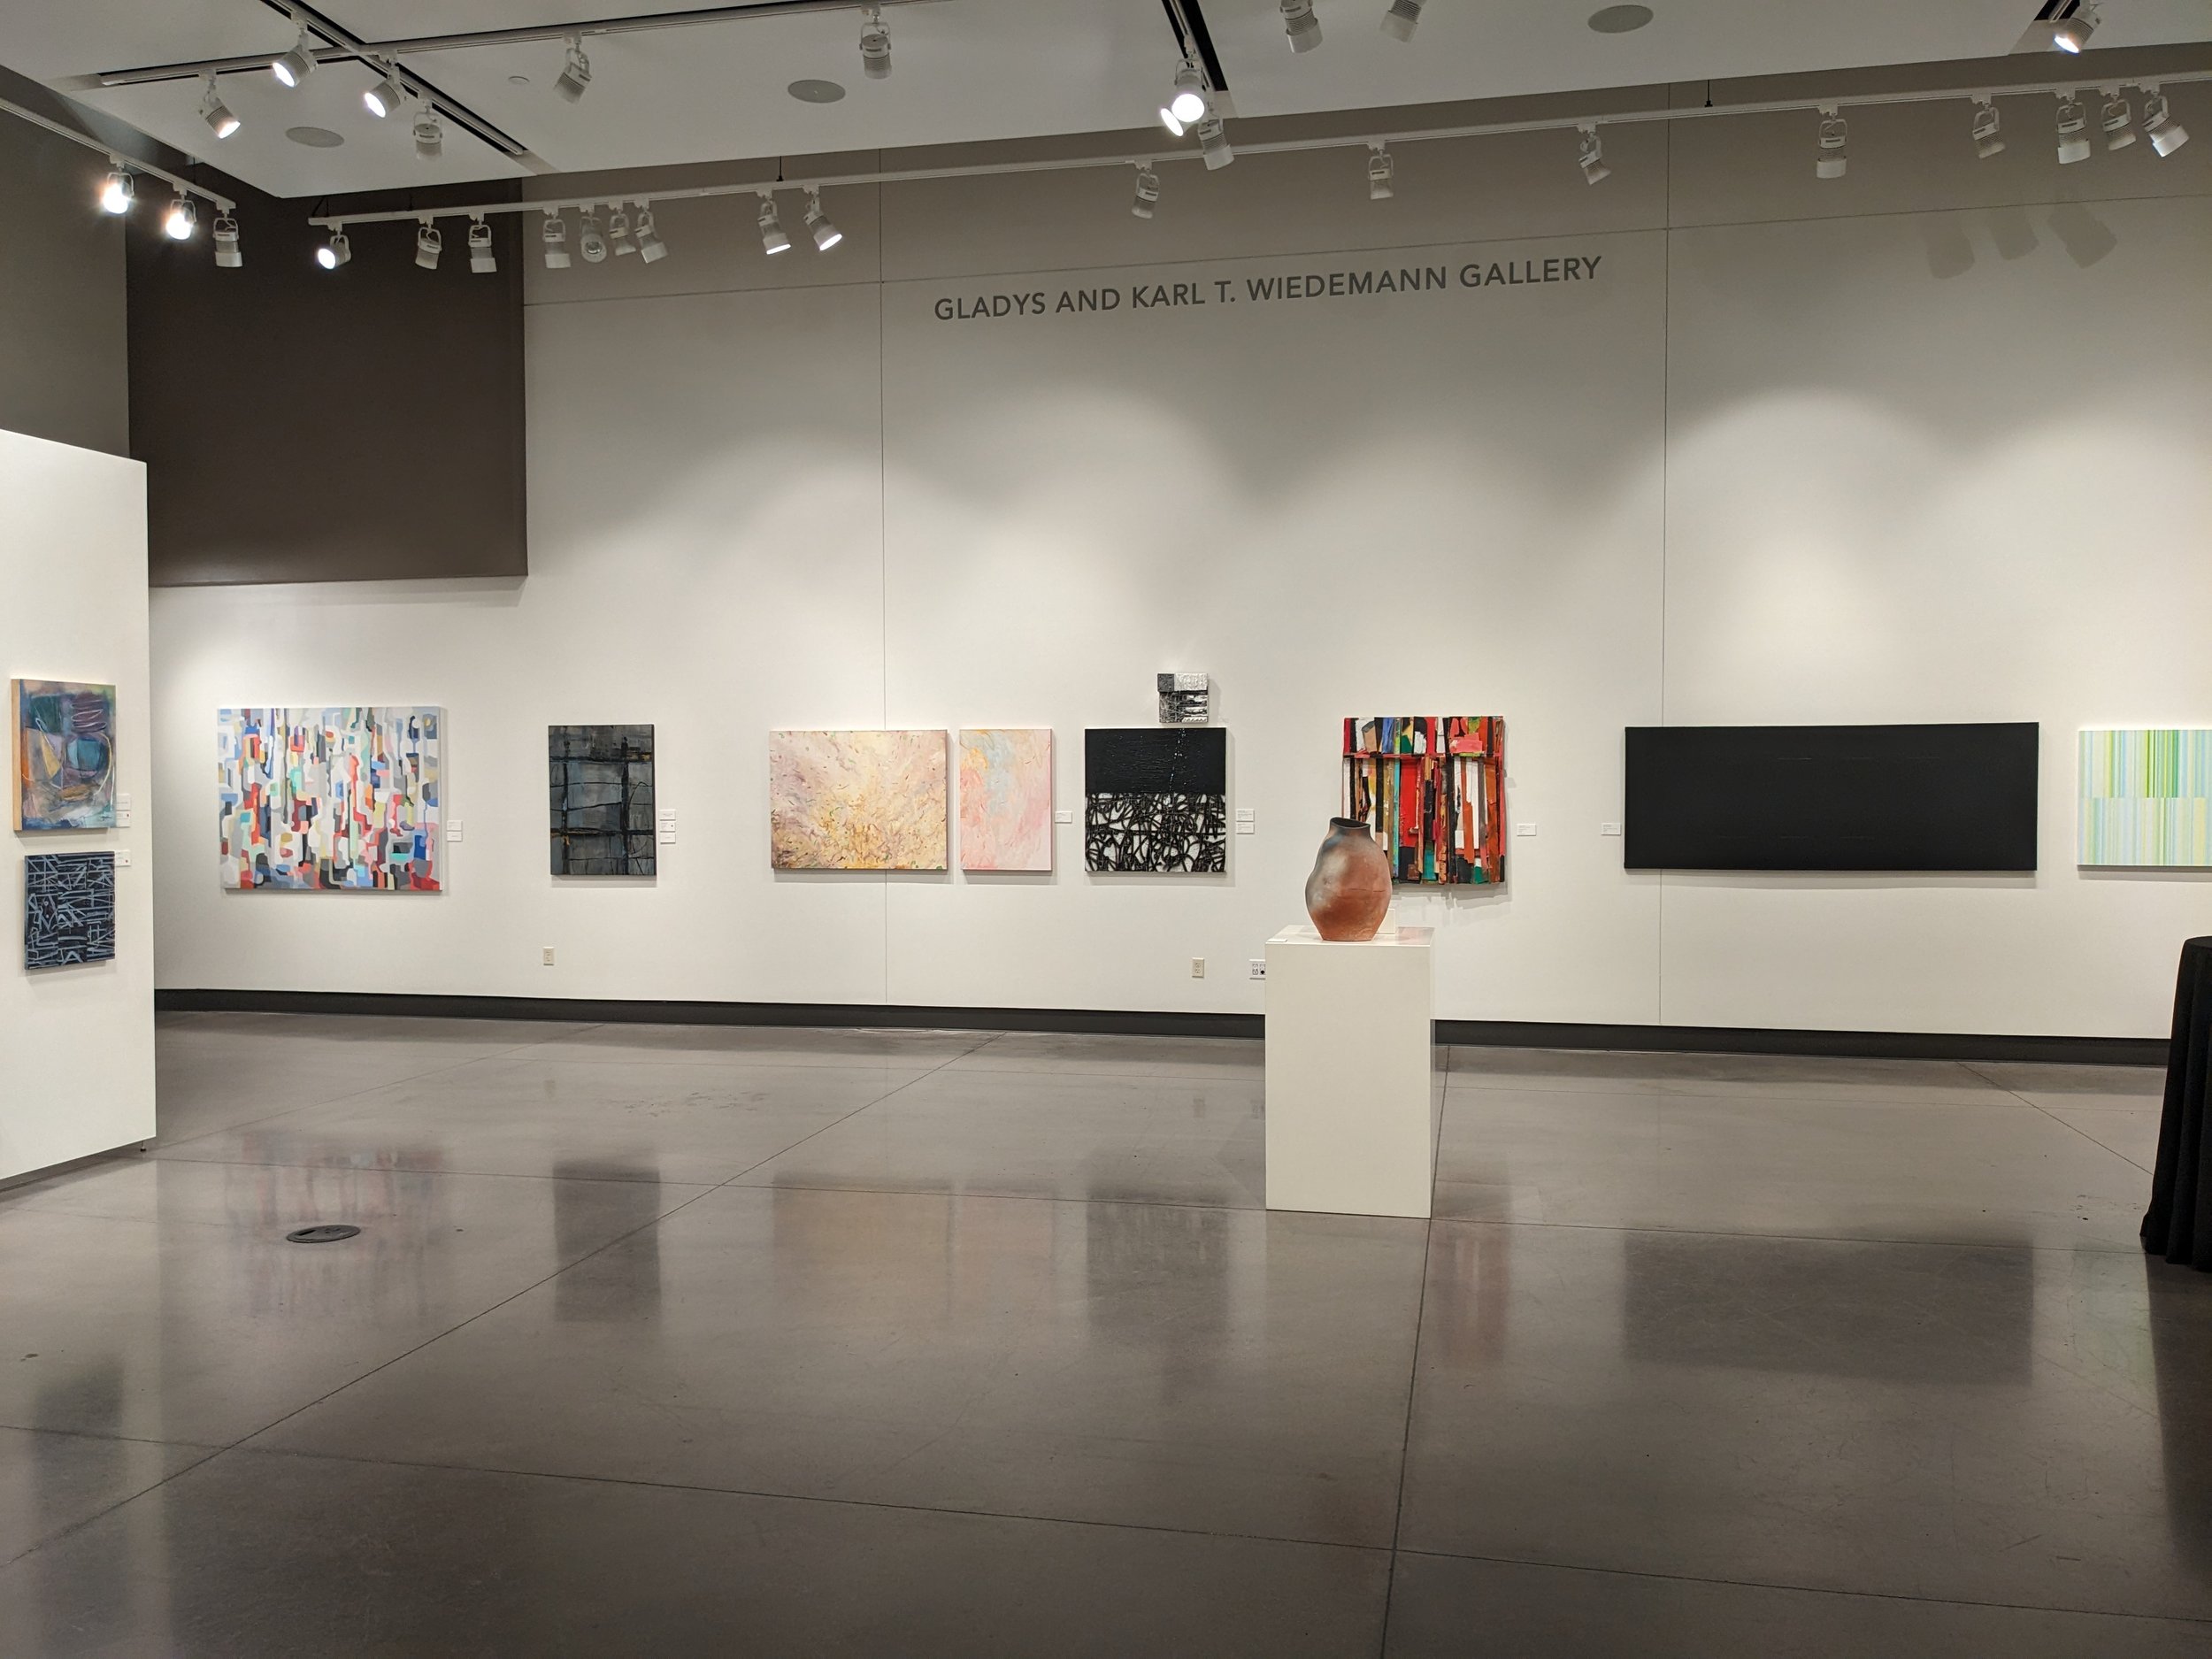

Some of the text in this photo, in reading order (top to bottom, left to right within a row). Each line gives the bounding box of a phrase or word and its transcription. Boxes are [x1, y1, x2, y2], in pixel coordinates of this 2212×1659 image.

[934, 255, 1602, 320] GLADYS AND KARL T. WIEDEMANN GALLERY
